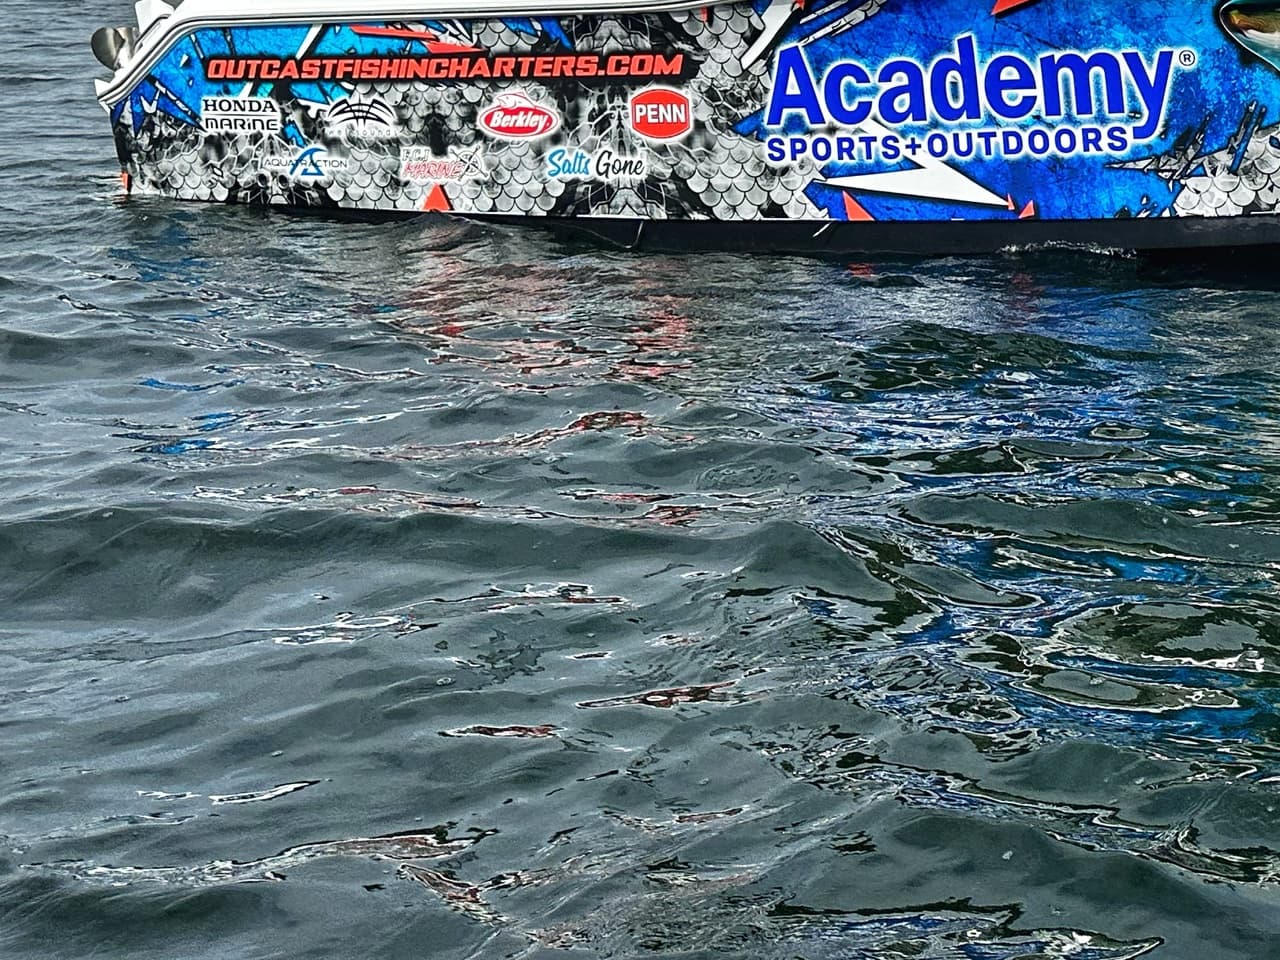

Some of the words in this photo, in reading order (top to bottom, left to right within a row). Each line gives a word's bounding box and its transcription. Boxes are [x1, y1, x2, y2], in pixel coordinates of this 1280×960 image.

[207, 54, 684, 80] OUTCASTFISHINCHARTERS.COM
[203, 98, 278, 114] HONDA
[634, 103, 686, 124] PENN
[489, 109, 549, 134] Berkley
[767, 125, 1129, 163] SPORTS+OUTDOORS
[264, 158, 348, 169] AQUATRACTION
[547, 148, 590, 177] Salts
[595, 150, 645, 178] Gone
